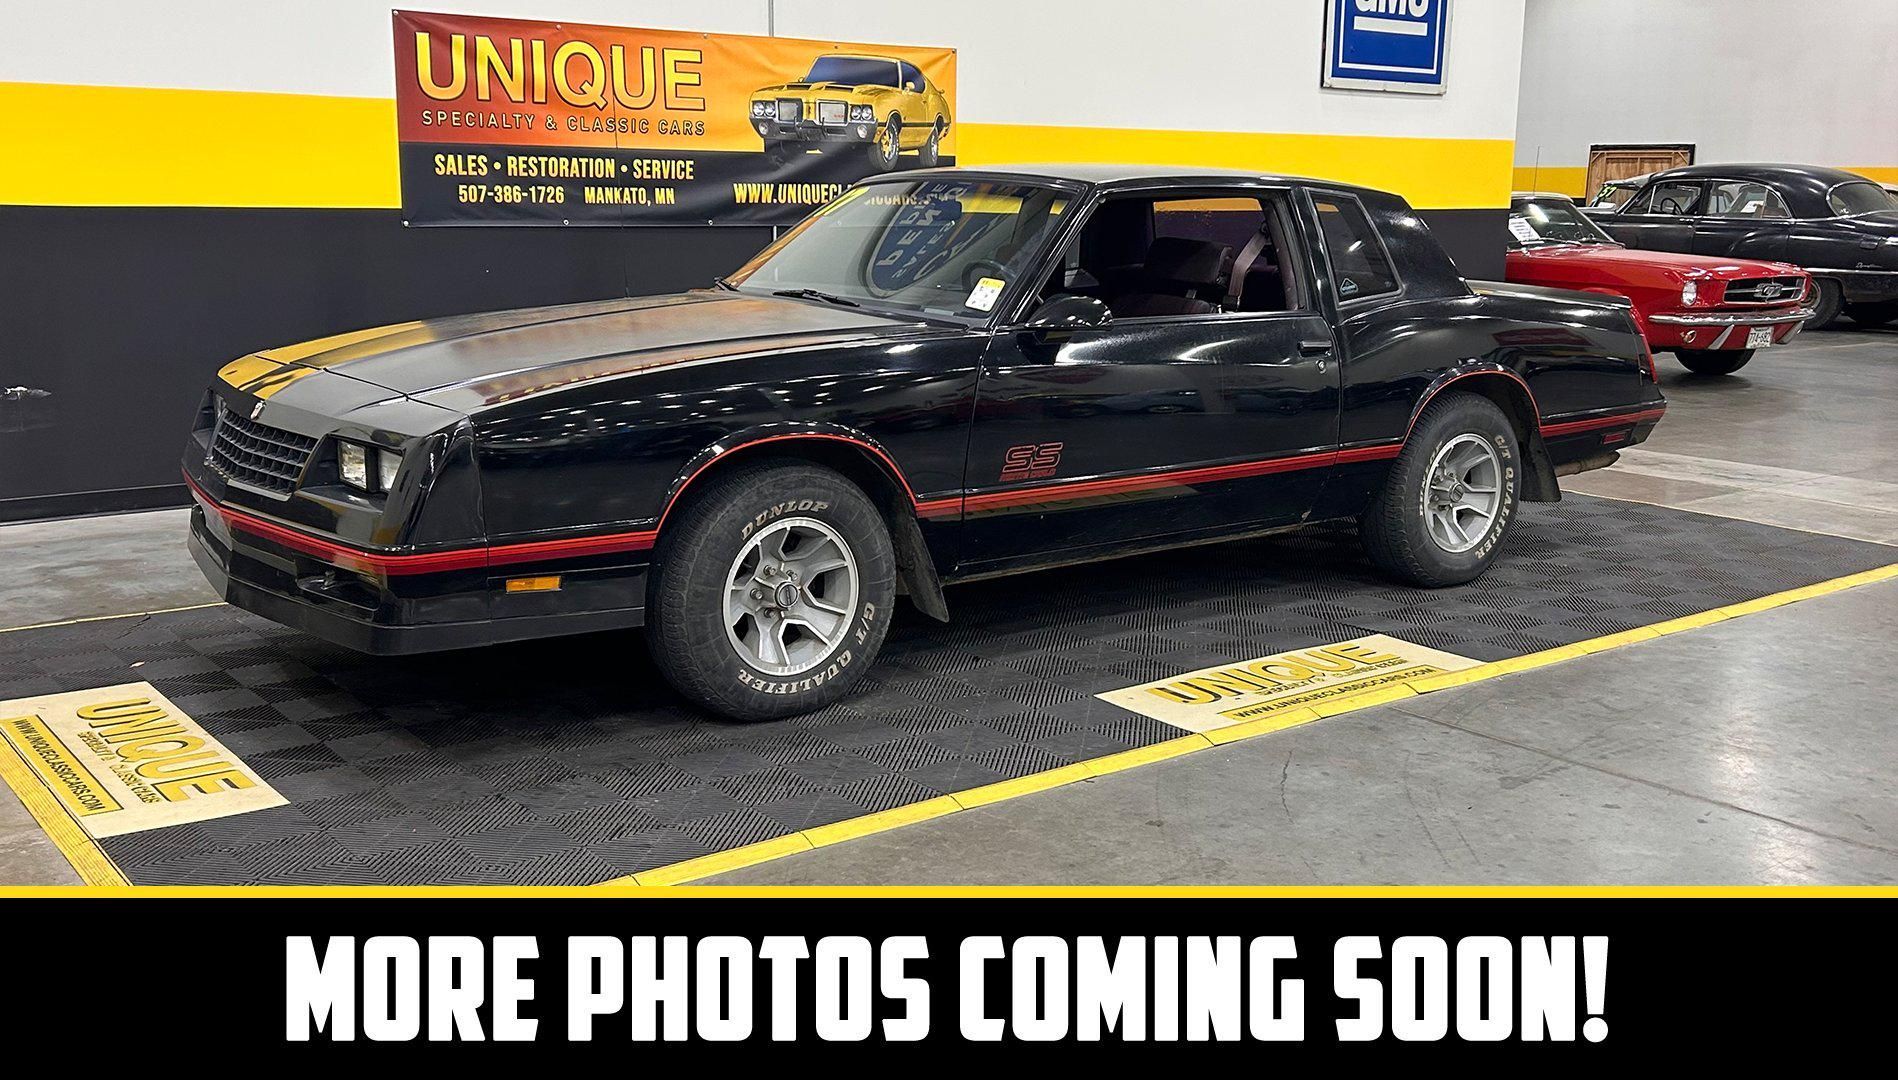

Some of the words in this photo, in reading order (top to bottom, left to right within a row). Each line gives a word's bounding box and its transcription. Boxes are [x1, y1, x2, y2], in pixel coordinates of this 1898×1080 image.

[414, 31, 706, 112] UNIQUE
[421, 110, 535, 129] SPECIALTY
[545, 114, 558, 131] &
[567, 115, 650, 134] CLASSIC
[658, 119, 705, 135] CARS
[434, 153, 489, 177] SALES
[507, 155, 616, 179] RESTORATION
[633, 158, 695, 180] SERVICE
[458, 184, 565, 204] 507-386-1726
[584, 185, 652, 207] MANKATO,
[655, 186, 676, 205] MN
[1002, 442, 1063, 473] SS
[740, 499, 829, 541] DUNLOP
[1475, 466, 1514, 560] QUALIFIER
[856, 602, 875, 646] G/T
[737, 649, 852, 695] QUALIFIER
[1144, 642, 1401, 706] UNIQUE
[11, 718, 106, 812] WWW.UNIQUECLASSICCARS.COM
[76, 697, 257, 802] UNIQUE
